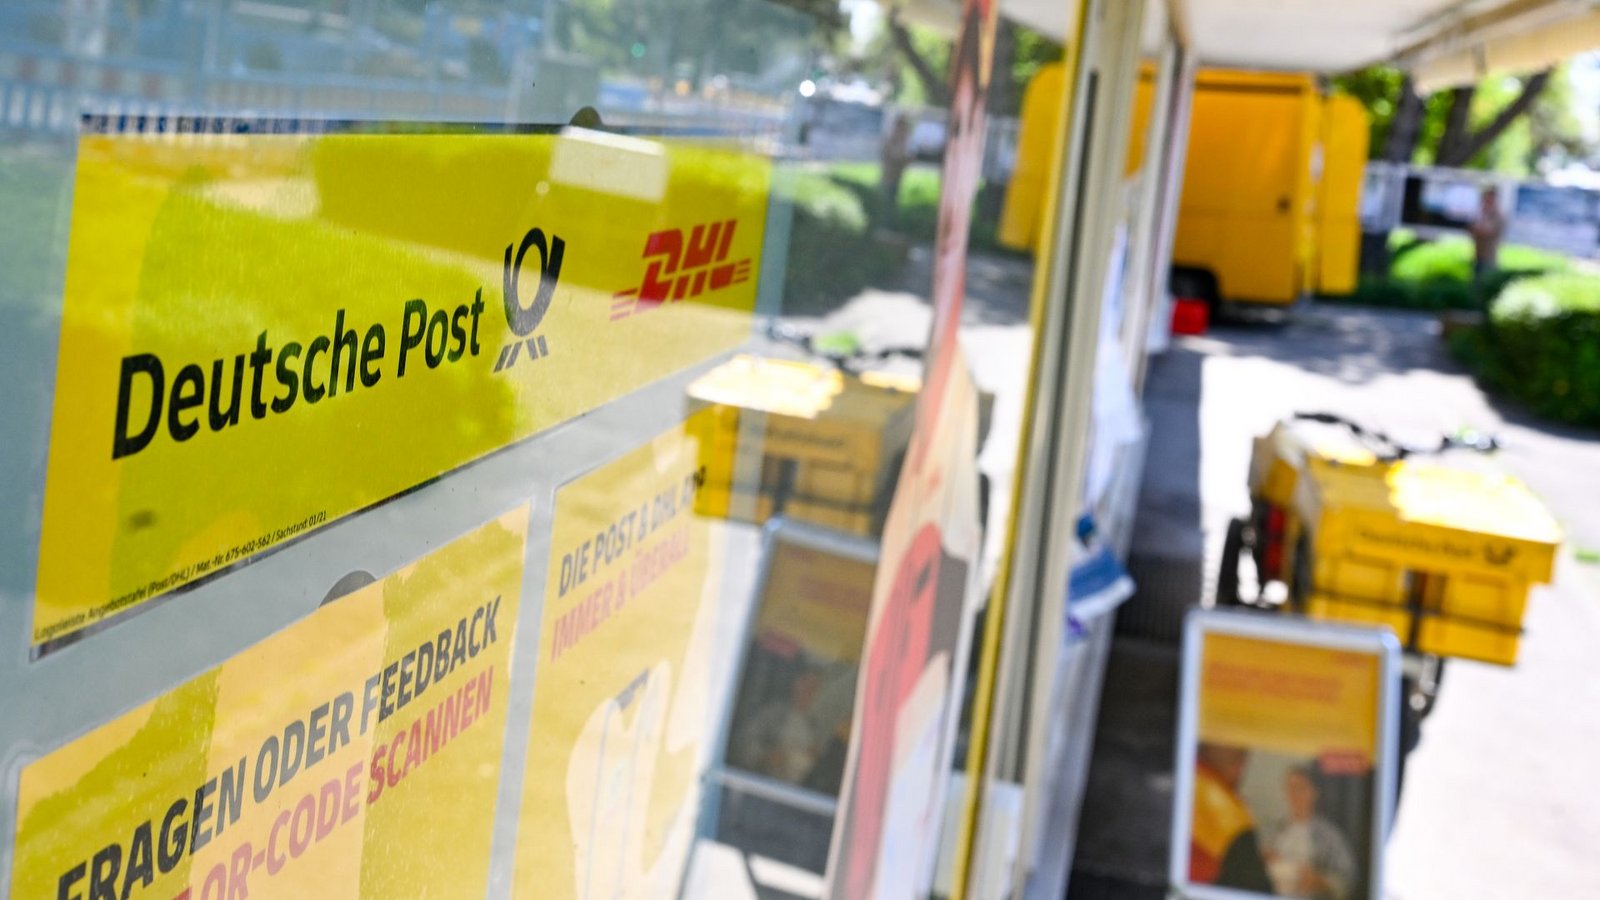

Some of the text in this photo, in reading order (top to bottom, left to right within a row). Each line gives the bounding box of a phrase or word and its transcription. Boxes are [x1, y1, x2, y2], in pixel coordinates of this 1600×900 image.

[634, 219, 738, 309] DHL
[111, 288, 485, 460] Deutsche Post
[88, 585, 148, 619] Angebotstafel
[148, 569, 190, 595] (Post/DHL)
[225, 534, 271, 562] 675-602-562
[308, 510, 327, 527] 01/21
[558, 540, 591, 599] DIE
[592, 510, 638, 575] POST
[639, 501, 650, 543] &
[551, 580, 612, 664] IMMER
[615, 568, 627, 611] &
[56, 596, 502, 900] FRAGEN ODER FEEDBACK
[366, 665, 495, 806] SCANNEN
